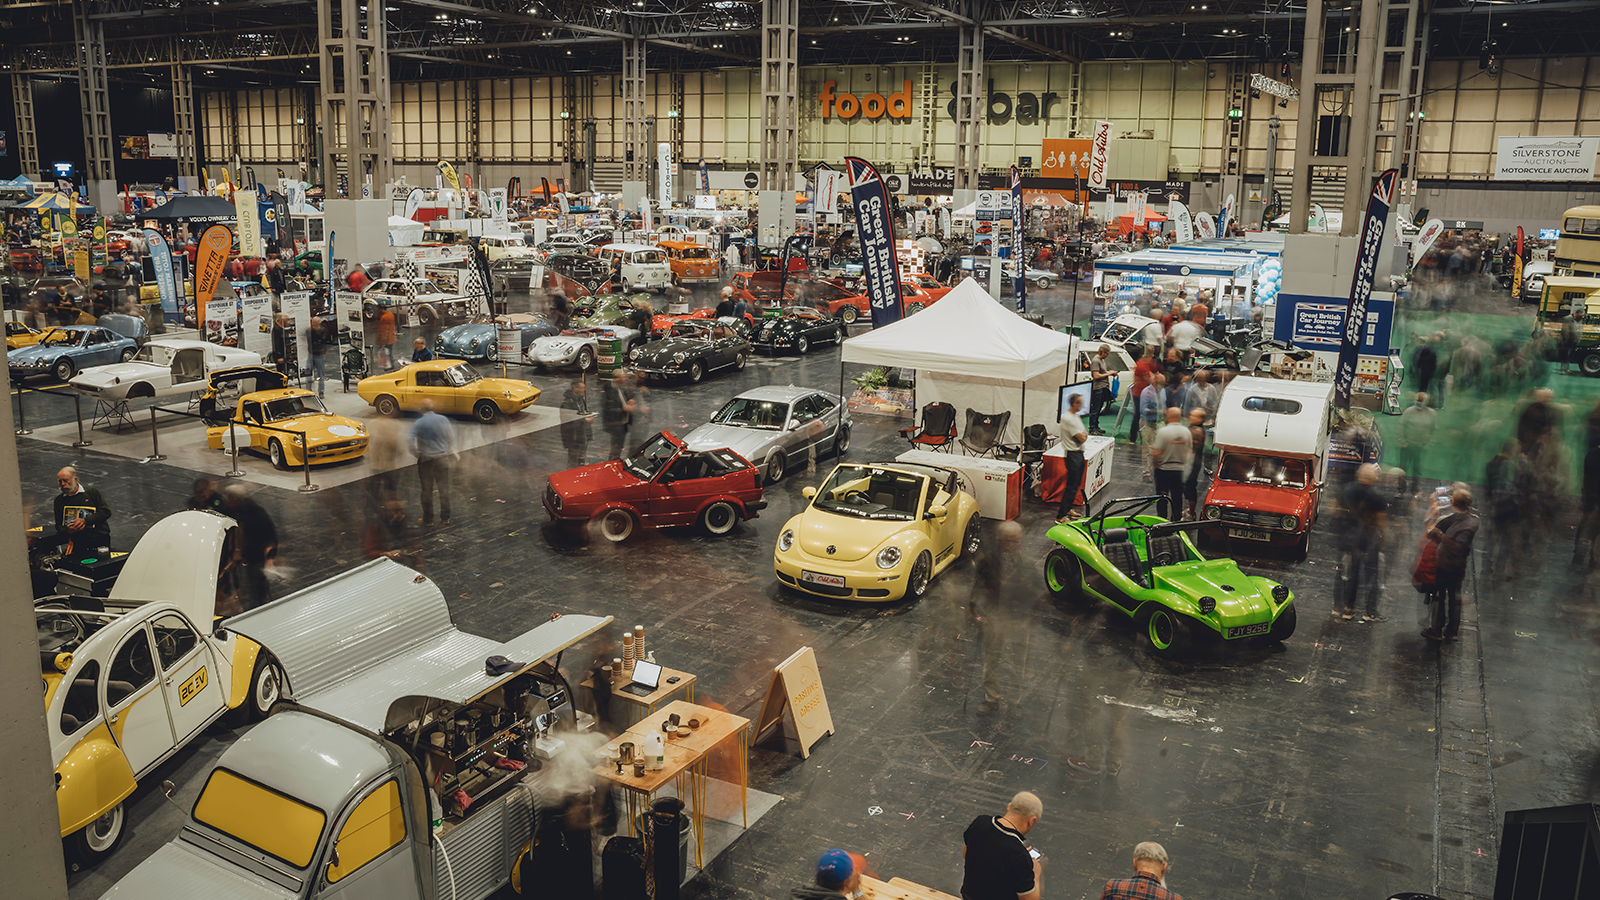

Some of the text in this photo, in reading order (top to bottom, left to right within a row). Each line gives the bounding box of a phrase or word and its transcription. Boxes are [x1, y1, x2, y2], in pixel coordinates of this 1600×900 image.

[818, 79, 912, 118] food
[986, 78, 1057, 118] bar
[1091, 123, 1109, 185] Odd Autos
[1512, 149, 1581, 157] SILVERSTONE
[911, 168, 955, 180] MADE
[1120, 182, 1134, 190] FOOD
[215, 254, 224, 270] CLUB
[859, 199, 884, 309] Car Journey
[868, 195, 896, 307] Great British
[1346, 214, 1377, 343] Car Journey
[1353, 219, 1384, 346] Great British
[1313, 319, 1341, 327] Journey
[1233, 529, 1267, 540] TJU 219N
[1228, 623, 1268, 637] FJY 925E
[793, 680, 819, 707] POSITIVE
[800, 694, 820, 718] COFFEE
